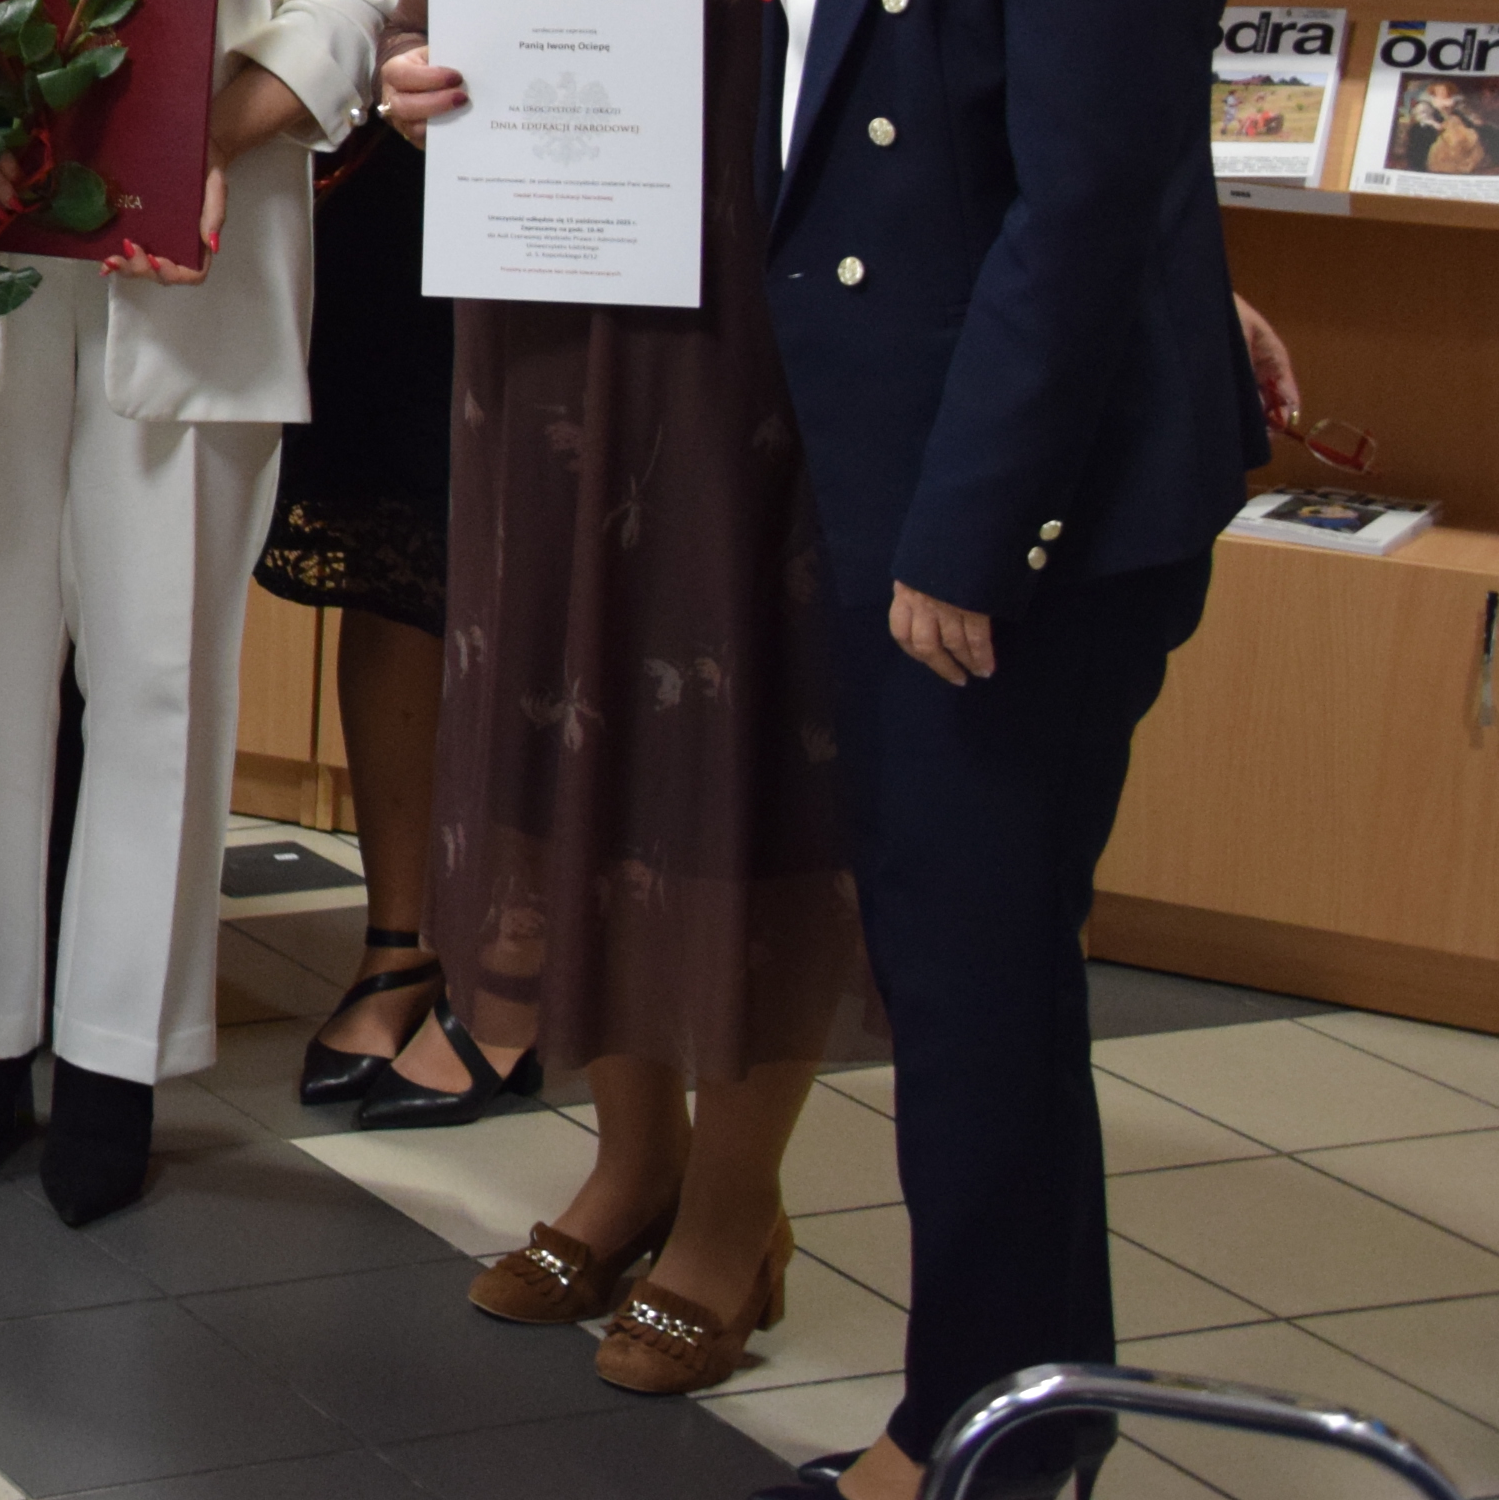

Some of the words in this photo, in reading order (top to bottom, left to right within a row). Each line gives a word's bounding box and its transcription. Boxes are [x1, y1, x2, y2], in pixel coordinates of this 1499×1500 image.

[519, 41, 544, 51] Panią
[547, 42, 575, 51] Iwonę
[578, 42, 610, 52] Ociepę
[1212, 11, 1334, 55] dra
